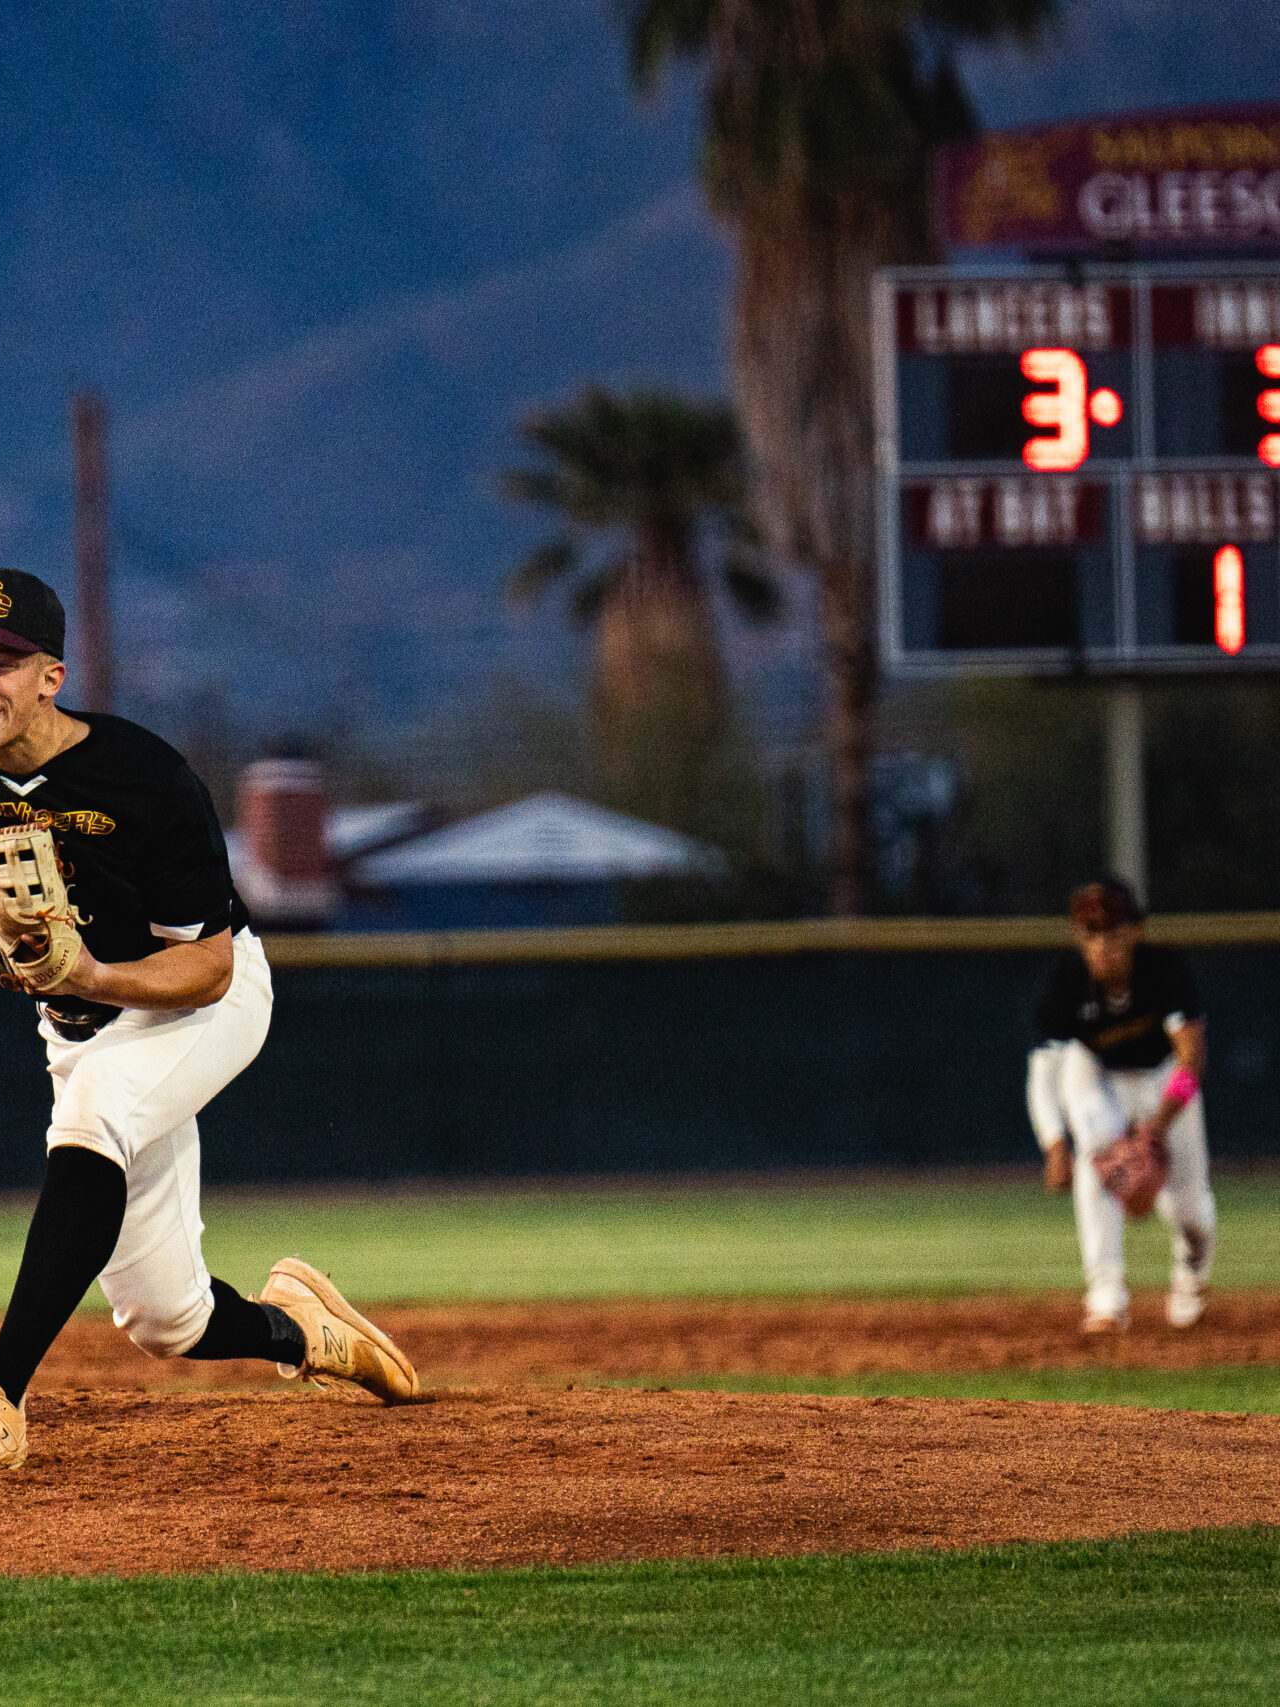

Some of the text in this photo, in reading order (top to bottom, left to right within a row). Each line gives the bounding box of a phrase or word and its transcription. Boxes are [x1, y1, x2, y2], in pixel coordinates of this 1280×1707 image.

[915, 284, 1112, 351] LANCERS
[1196, 284, 1280, 346] INN
[1020, 347, 1089, 472] 3
[927, 476, 1077, 546] AT BAT
[1136, 474, 1273, 542] BALLS
[1213, 544, 1245, 655] 1
